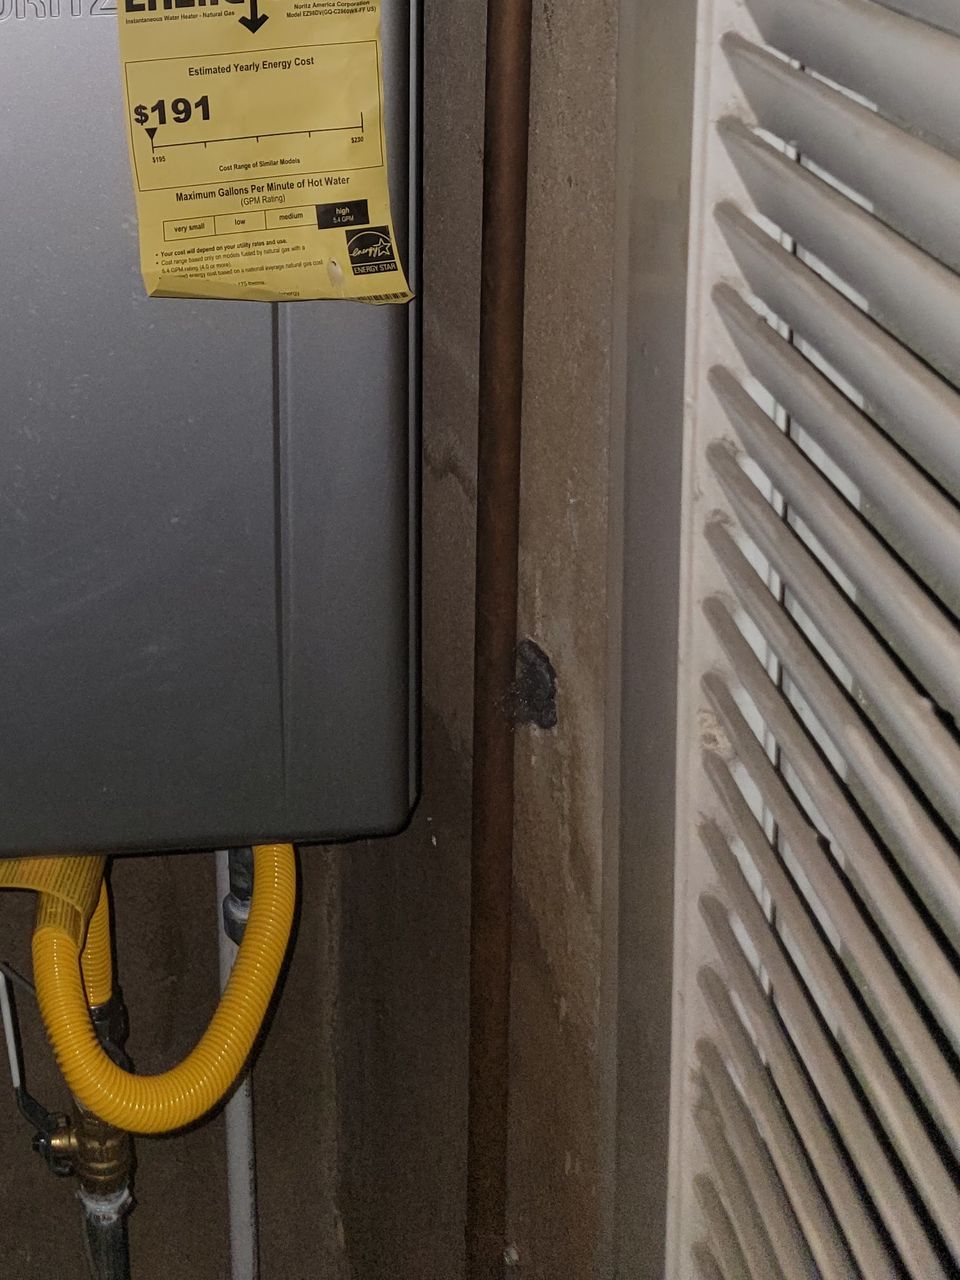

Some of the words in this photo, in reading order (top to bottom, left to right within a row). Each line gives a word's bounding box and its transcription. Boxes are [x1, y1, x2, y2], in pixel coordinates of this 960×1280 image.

[294, 2, 311, 10] Noritz
[312, 1, 336, 9] America
[337, 0, 370, 8] Corporation
[126, 16, 163, 24] Instantaneous
[164, 14, 180, 22] Water
[181, 12, 198, 20] Heater
[188, 64, 231, 76] Estimated
[233, 62, 259, 73] Yearly
[262, 59, 291, 70] Energy
[294, 57, 314, 66] Cost
[134, 94, 211, 126] $191
[152, 155, 166, 164] $195
[219, 164, 232, 172] Cost
[233, 162, 251, 171] Range
[259, 159, 279, 167] Similar
[280, 157, 300, 165] Models
[176, 189, 216, 202] Maximum
[218, 185, 249, 197] Gallons
[251, 184, 264, 194] Per
[267, 180, 295, 192] Minute
[296, 178, 305, 188] of
[307, 177, 322, 187] Hot
[326, 175, 350, 186] Water
[240, 195, 260, 207] (GPM
[262, 193, 286, 205] Rating)
[279, 212, 303, 220] medium
[336, 207, 350, 216] high
[235, 218, 246, 226] low
[342, 215, 354, 223] GPM
[174, 225, 187, 233] very
[196, 246, 215, 254] depend
[224, 244, 235, 252] your
[281, 246, 290, 254] gas
[286, 261, 301, 269] natural
[354, 264, 379, 274] ENERGY
[380, 262, 396, 272] STAR
